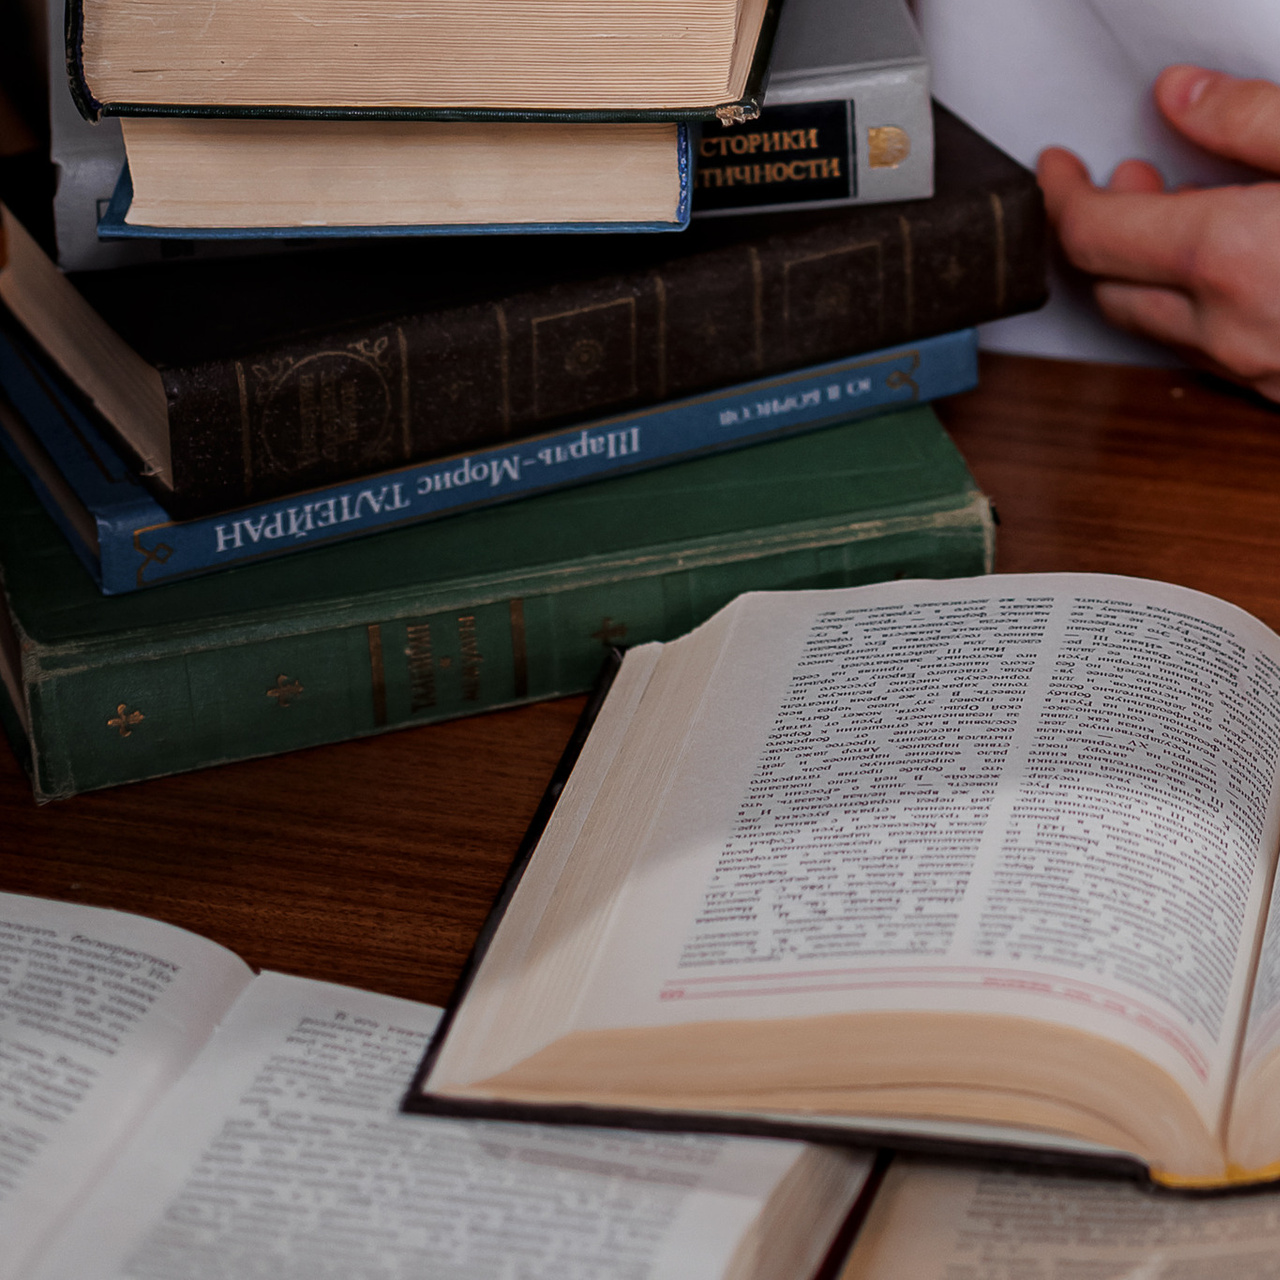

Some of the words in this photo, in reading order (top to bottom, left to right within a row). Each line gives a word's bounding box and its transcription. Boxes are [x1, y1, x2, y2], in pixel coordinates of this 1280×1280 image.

[417, 424, 641, 500] Шарль-Морис
[214, 480, 410, 554] ТАЛЕЙРАН
[926, 667, 989, 676] спасшего
[869, 672, 916, 681] Европу
[819, 680, 877, 692] русского
[888, 677, 941, 686] миссию
[1048, 682, 1085, 691] более
[817, 689, 873, 699] великую
[849, 695, 888, 704] время
[949, 696, 994, 704] провел
[1060, 698, 1093, 708] Руси
[780, 699, 839, 710] писатель
[866, 702, 900, 710] идею
[1190, 701, 1213, 715] для
[816, 705, 852, 714] через
[842, 710, 882, 719] может
[1040, 712, 1079, 720] главы
[1192, 710, 1213, 723] это
[850, 717, 883, 725] Руси
[1087, 715, 1110, 724] как
[1127, 706, 1198, 733] отношения
[835, 722, 910, 734] отношении
[892, 727, 961, 736] население
[1117, 720, 1155, 734] князя
[767, 730, 812, 740] борьбе
[1217, 723, 1247, 745] Дело
[765, 735, 831, 747] боярского
[824, 738, 877, 749] простое
[887, 735, 946, 744] отделить
[1161, 732, 1216, 759] великого
[794, 750, 829, 759] даже
[841, 746, 881, 755] Автор
[976, 748, 1009, 756] рало
